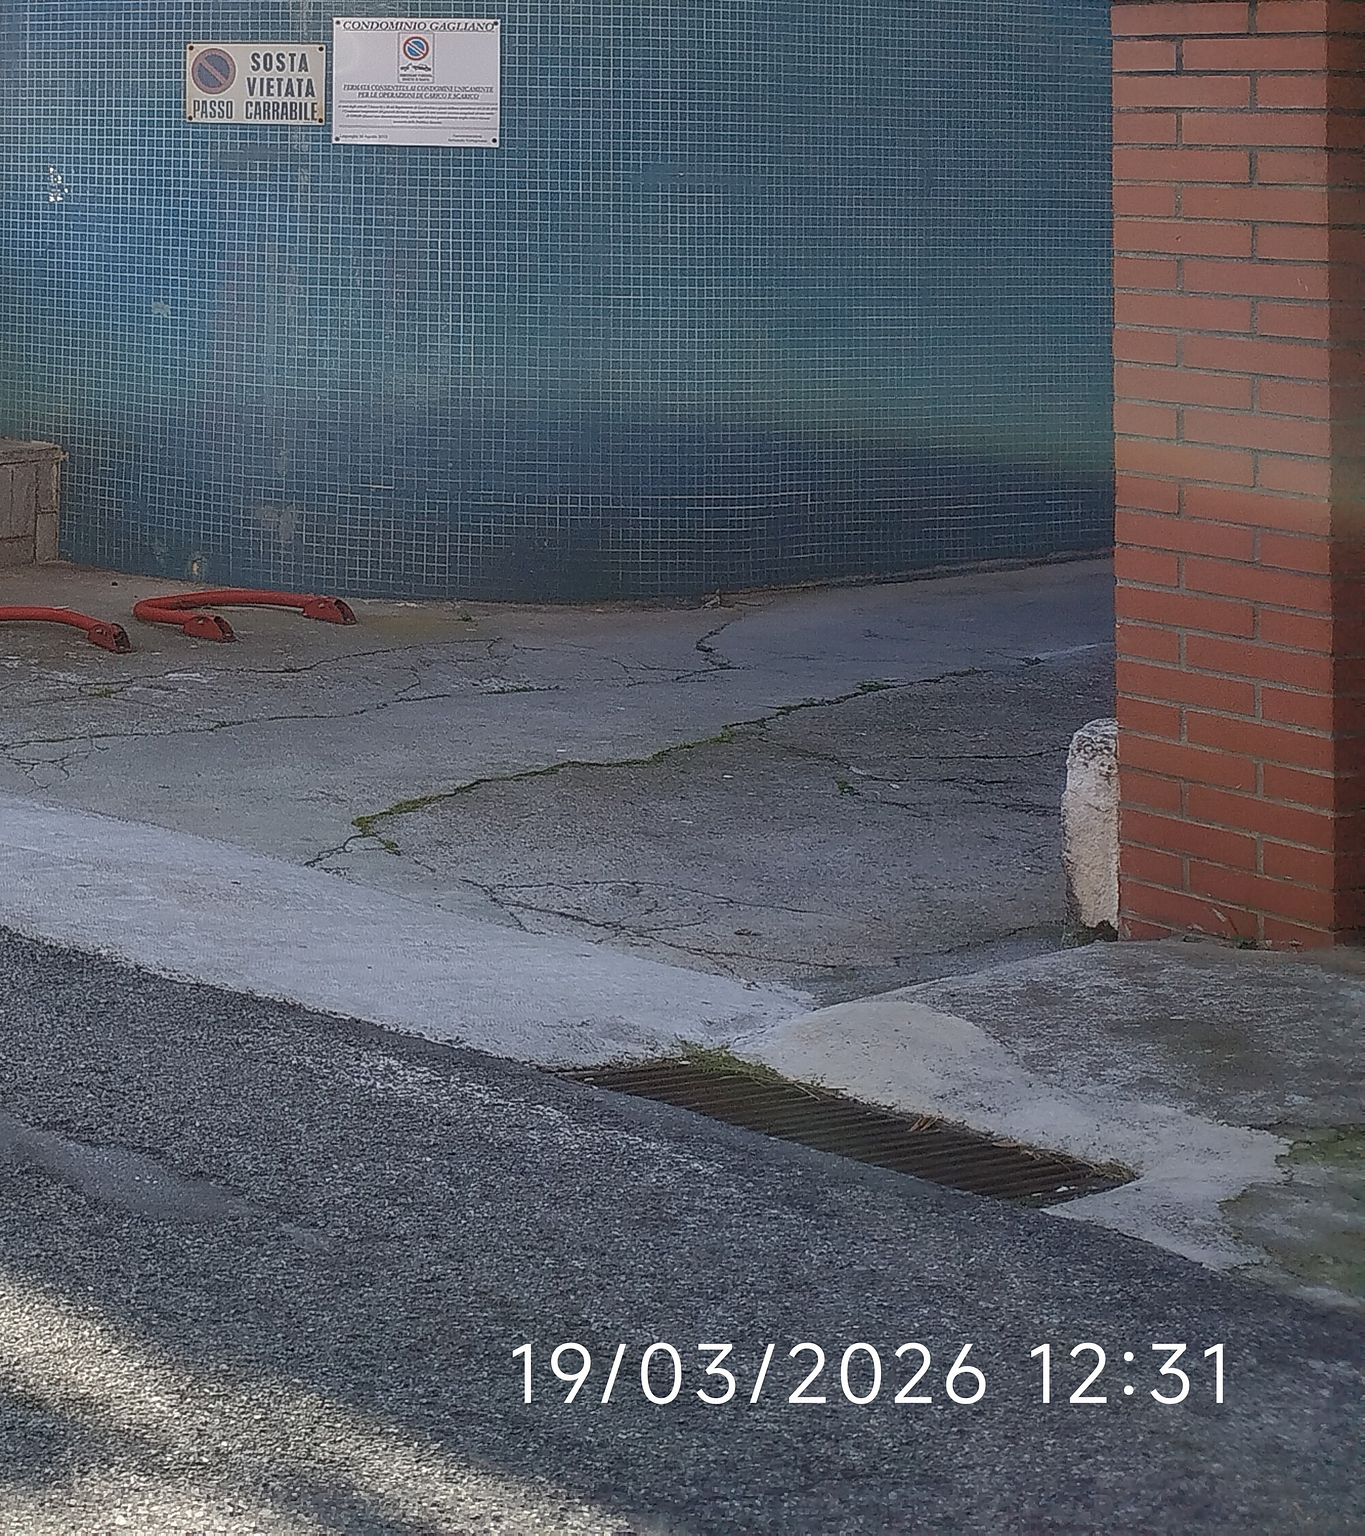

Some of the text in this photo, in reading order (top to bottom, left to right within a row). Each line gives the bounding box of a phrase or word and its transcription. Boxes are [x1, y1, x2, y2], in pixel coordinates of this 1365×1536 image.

[343, 21, 495, 32] CONDOMINIO GAGLIANO
[250, 52, 309, 73] SOSTA
[247, 77, 316, 98] VIETATA
[193, 99, 319, 121] PASSO CARRABILE
